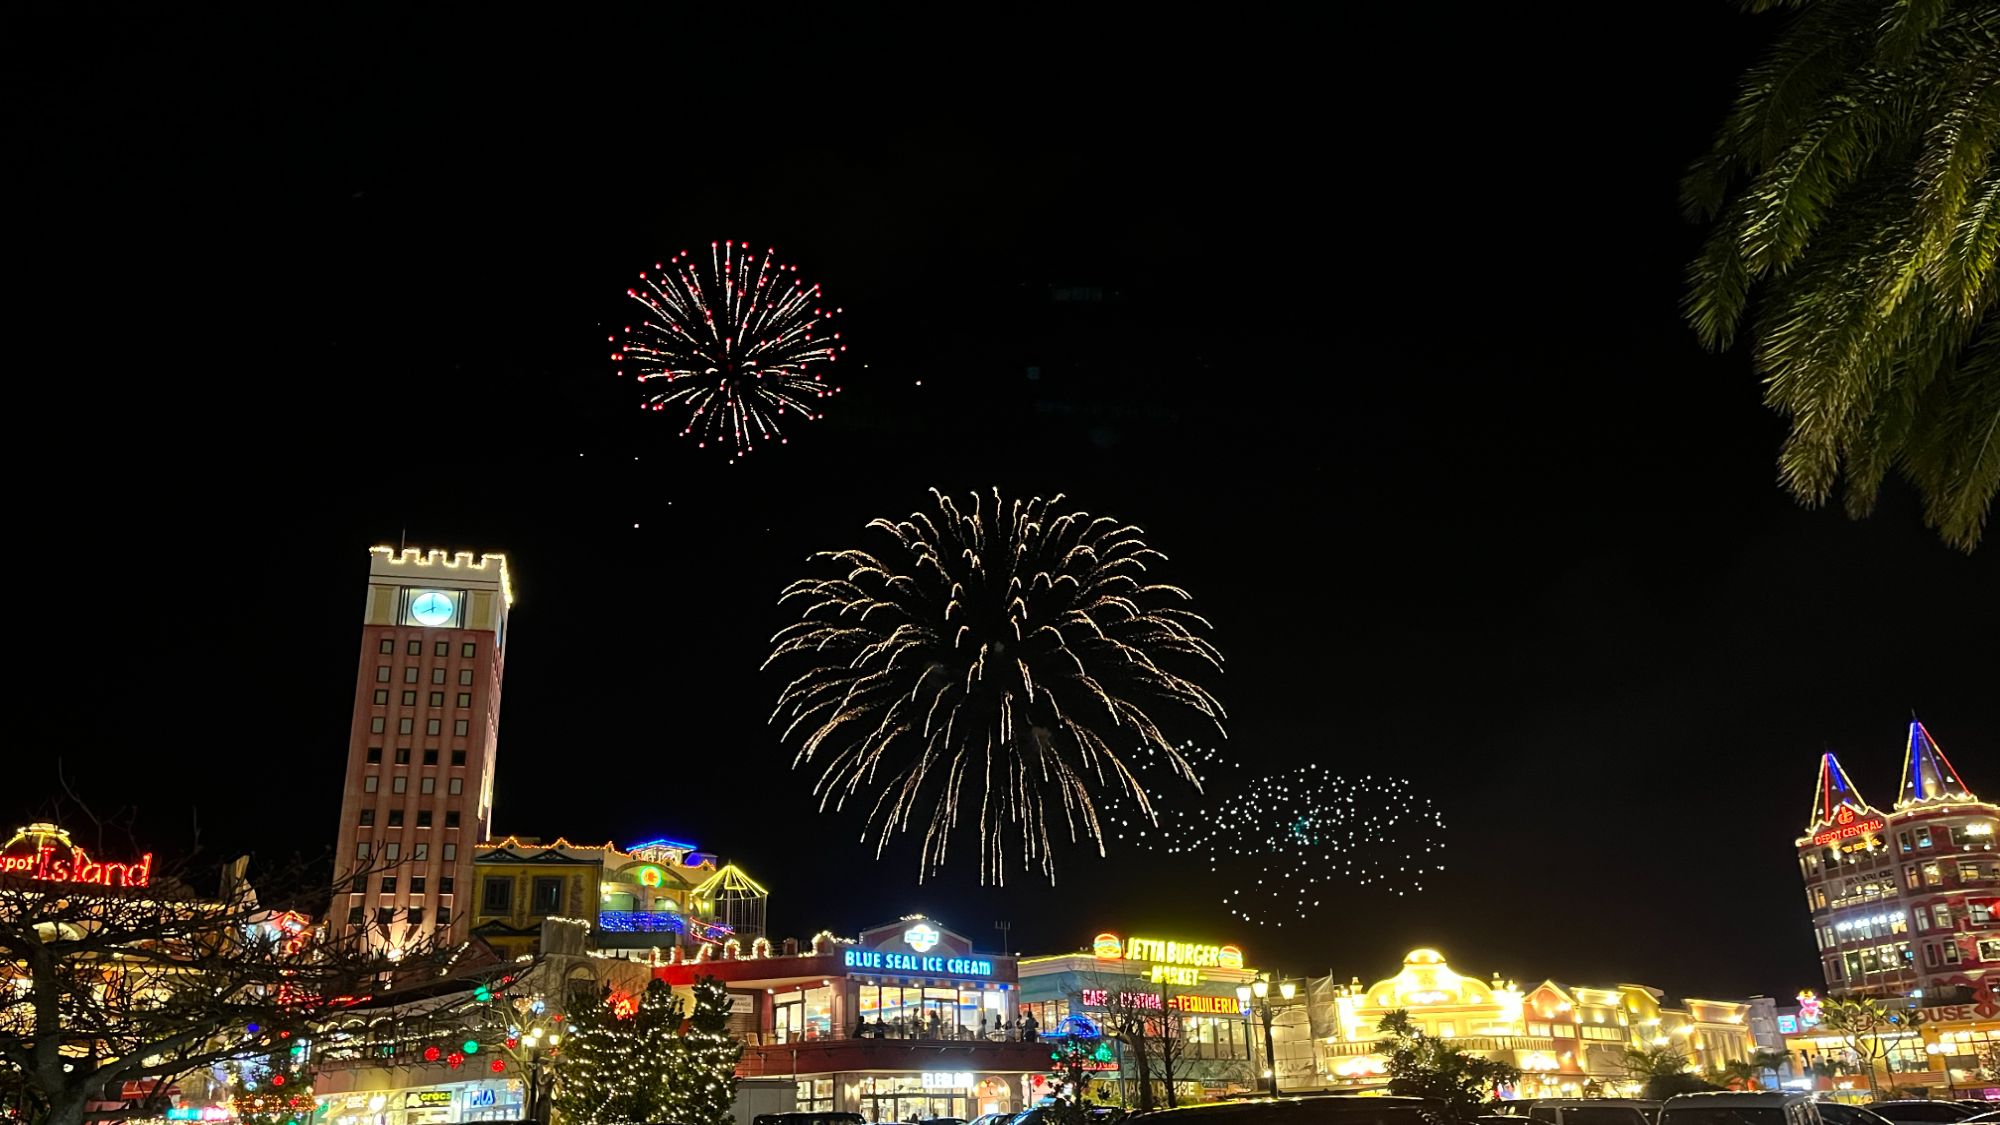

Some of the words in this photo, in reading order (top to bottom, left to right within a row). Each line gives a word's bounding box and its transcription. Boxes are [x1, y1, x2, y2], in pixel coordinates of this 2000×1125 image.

[1814, 830, 1841, 845] DEPOT
[1843, 820, 1882, 838] CENTRAL
[32, 847, 152, 887] Island
[845, 951, 881, 967] BLUE
[885, 954, 918, 970] SEAL
[923, 956, 943, 972] ICE
[947, 959, 991, 976] CREAM
[1167, 942, 1219, 966] BURGER
[420, 1092, 452, 1101] crocs
